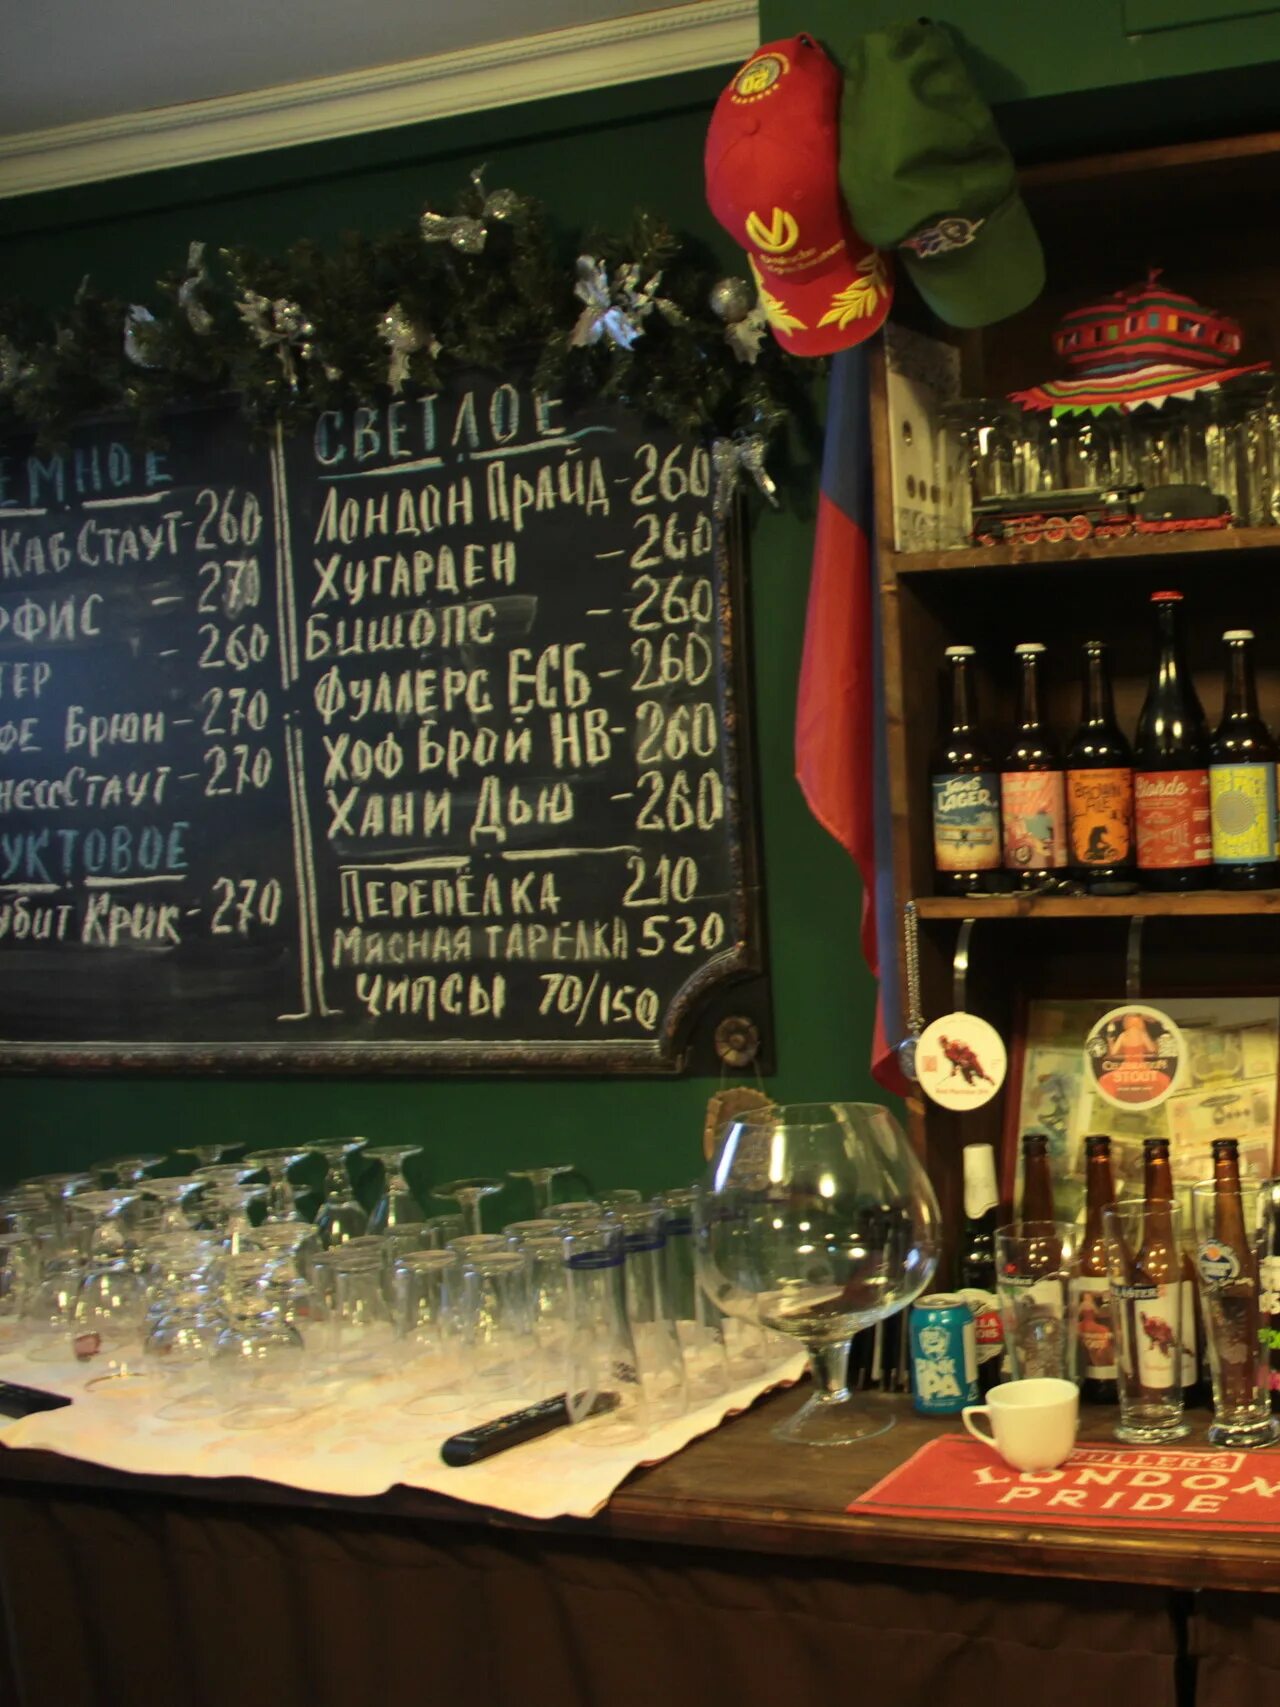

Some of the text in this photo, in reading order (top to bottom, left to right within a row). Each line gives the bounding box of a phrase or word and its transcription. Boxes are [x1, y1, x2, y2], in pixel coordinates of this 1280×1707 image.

[313, 384, 566, 465] СВЕТЛОЕ
[195, 487, 263, 550] 260
[314, 442, 712, 545] ЛОНДОН ПРАЙД 260
[198, 555, 261, 615] 270
[313, 511, 713, 608] ХУГАРДЕН 260
[198, 622, 270, 671] 260
[304, 574, 714, 661] БИШОПС 260
[314, 631, 713, 725] ФУЛЛЕРС ЕСБ 260
[201, 686, 269, 736] 270
[203, 745, 273, 797] 270
[322, 728, 404, 787] ХОФ
[635, 699, 718, 765] 260
[326, 767, 725, 843] ХАНИ ДЬЮ 260
[937, 787, 991, 813] LAGER
[211, 876, 282, 934] 270
[338, 854, 698, 923] ПЕРЕПЁЛКА 210
[332, 911, 725, 969] МЯСНАЯ ТАРЕЛКА 520
[355, 972, 660, 1030] ЧИПСЫ 70/150
[996, 1485, 1230, 1514] PRIDE
